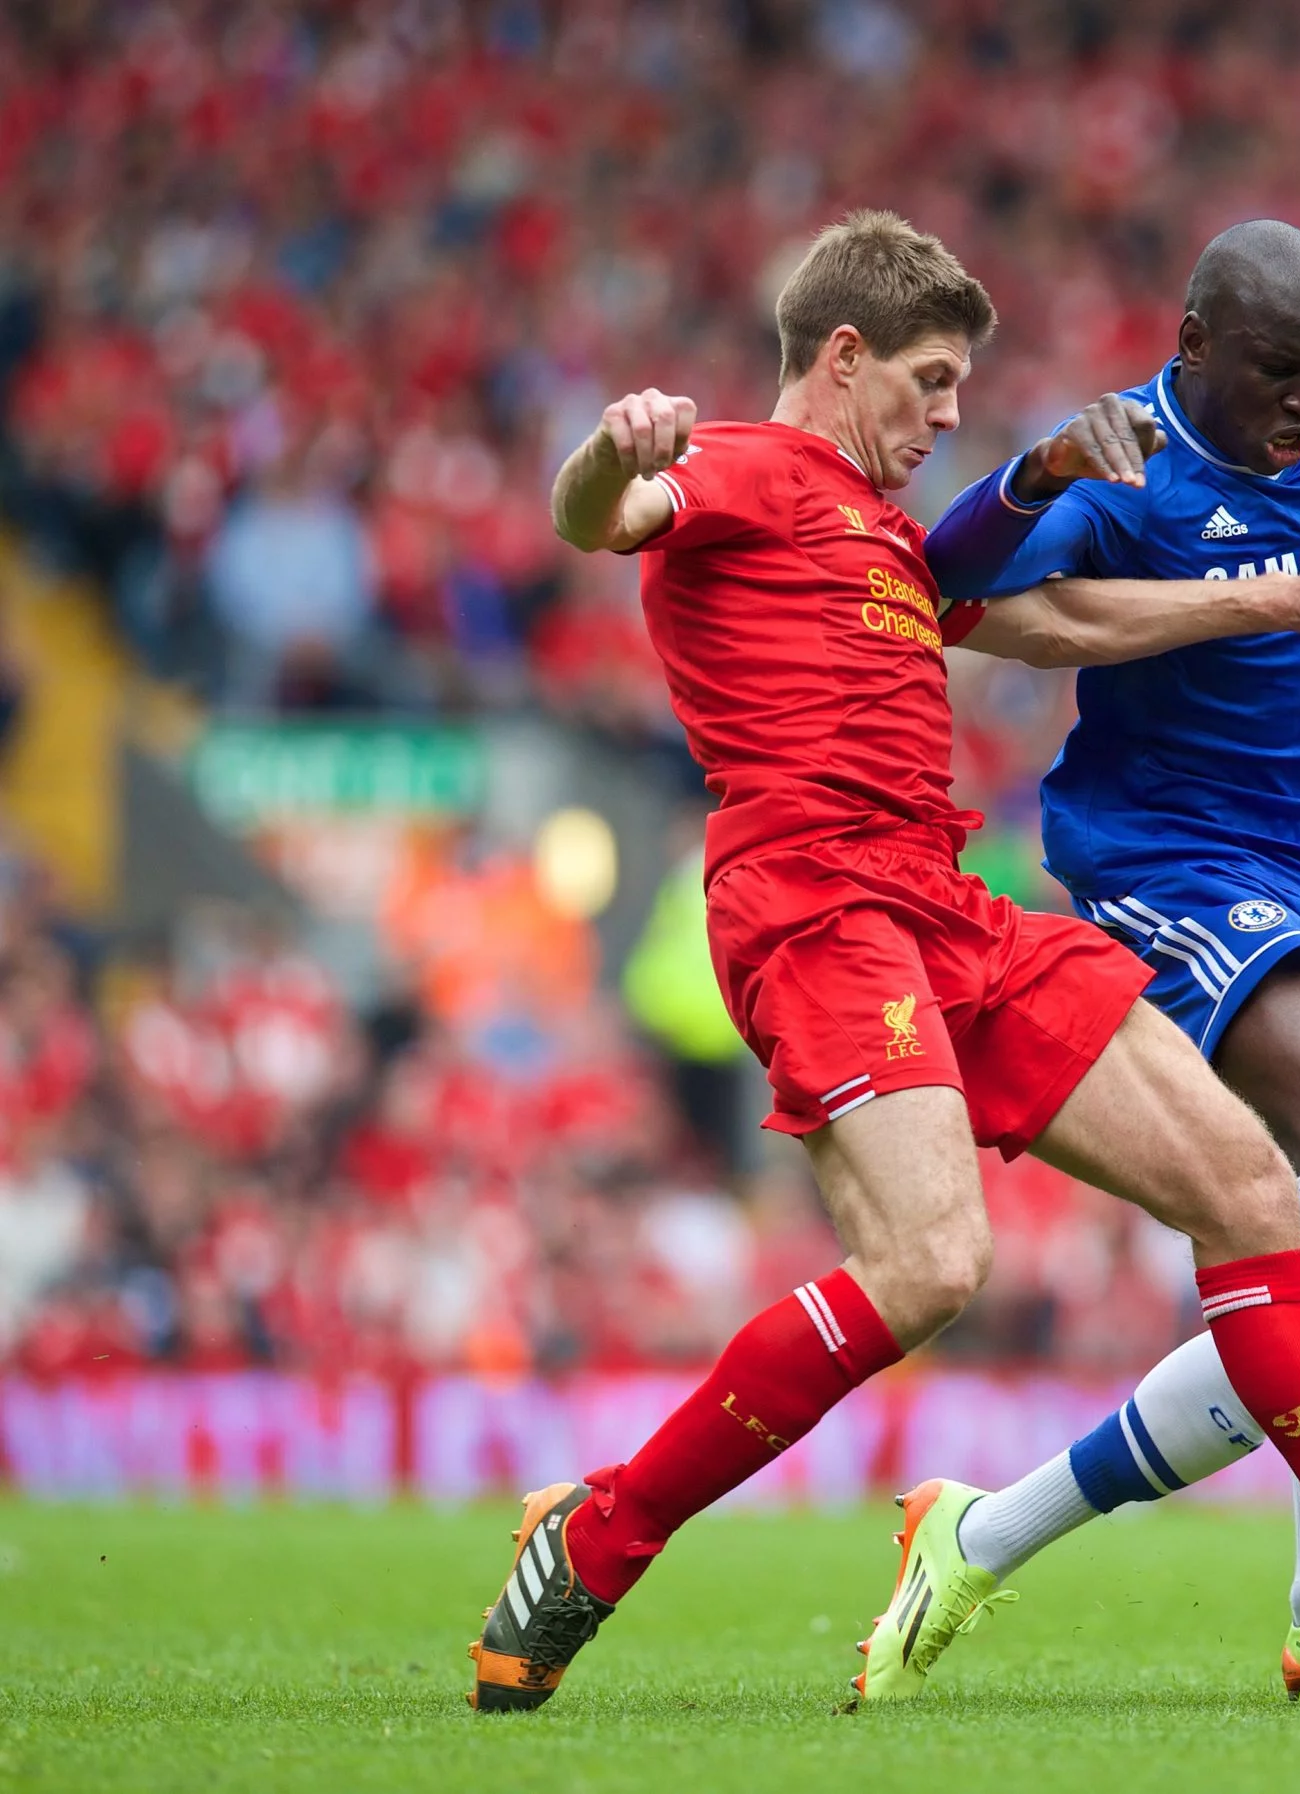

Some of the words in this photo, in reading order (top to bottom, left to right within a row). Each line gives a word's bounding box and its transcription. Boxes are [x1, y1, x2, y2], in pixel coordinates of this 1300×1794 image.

[1201, 522, 1249, 540] adidas
[861, 601, 942, 654] Chartere
[1209, 1406, 1264, 1453] CF
